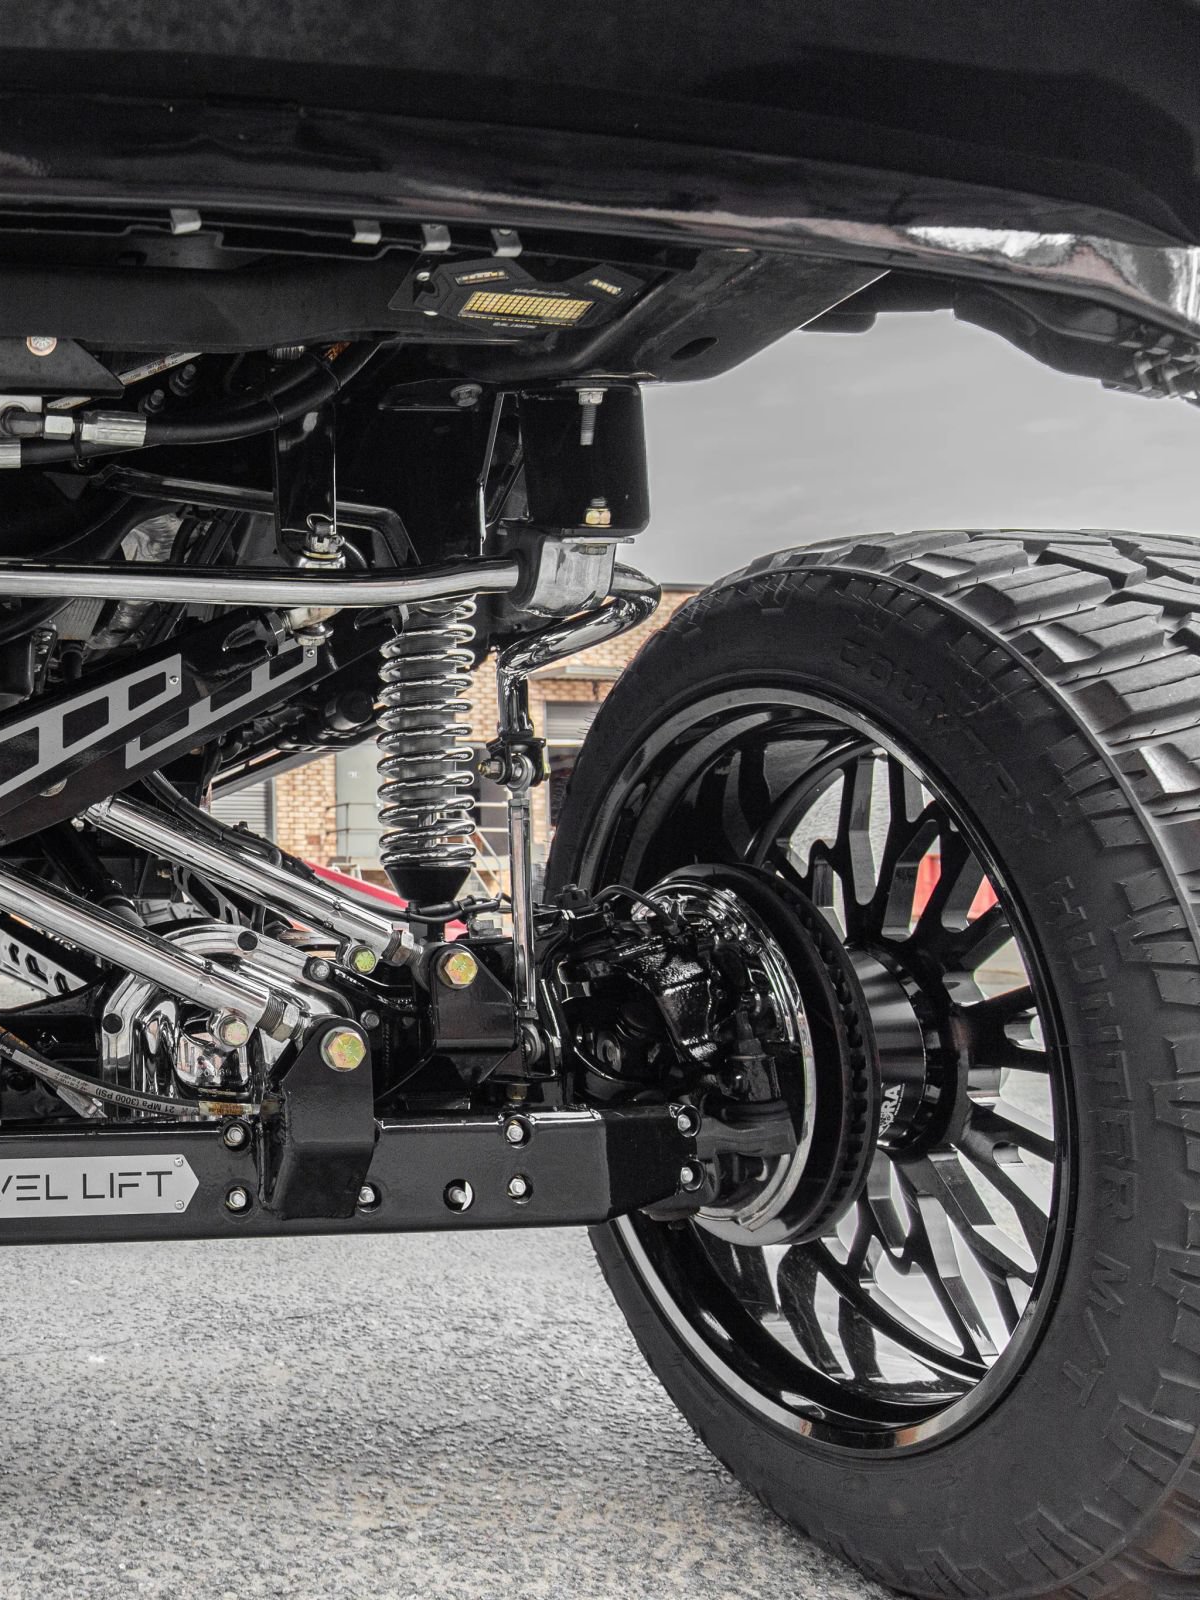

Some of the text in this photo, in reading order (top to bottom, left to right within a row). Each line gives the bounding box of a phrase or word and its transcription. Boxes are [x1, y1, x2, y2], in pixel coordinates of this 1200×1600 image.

[95, 1087, 114, 1100] PSI)
[115, 1094, 140, 1107] (3000
[142, 1100, 162, 1111] MPa
[82, 1170, 173, 1200] LIFT
